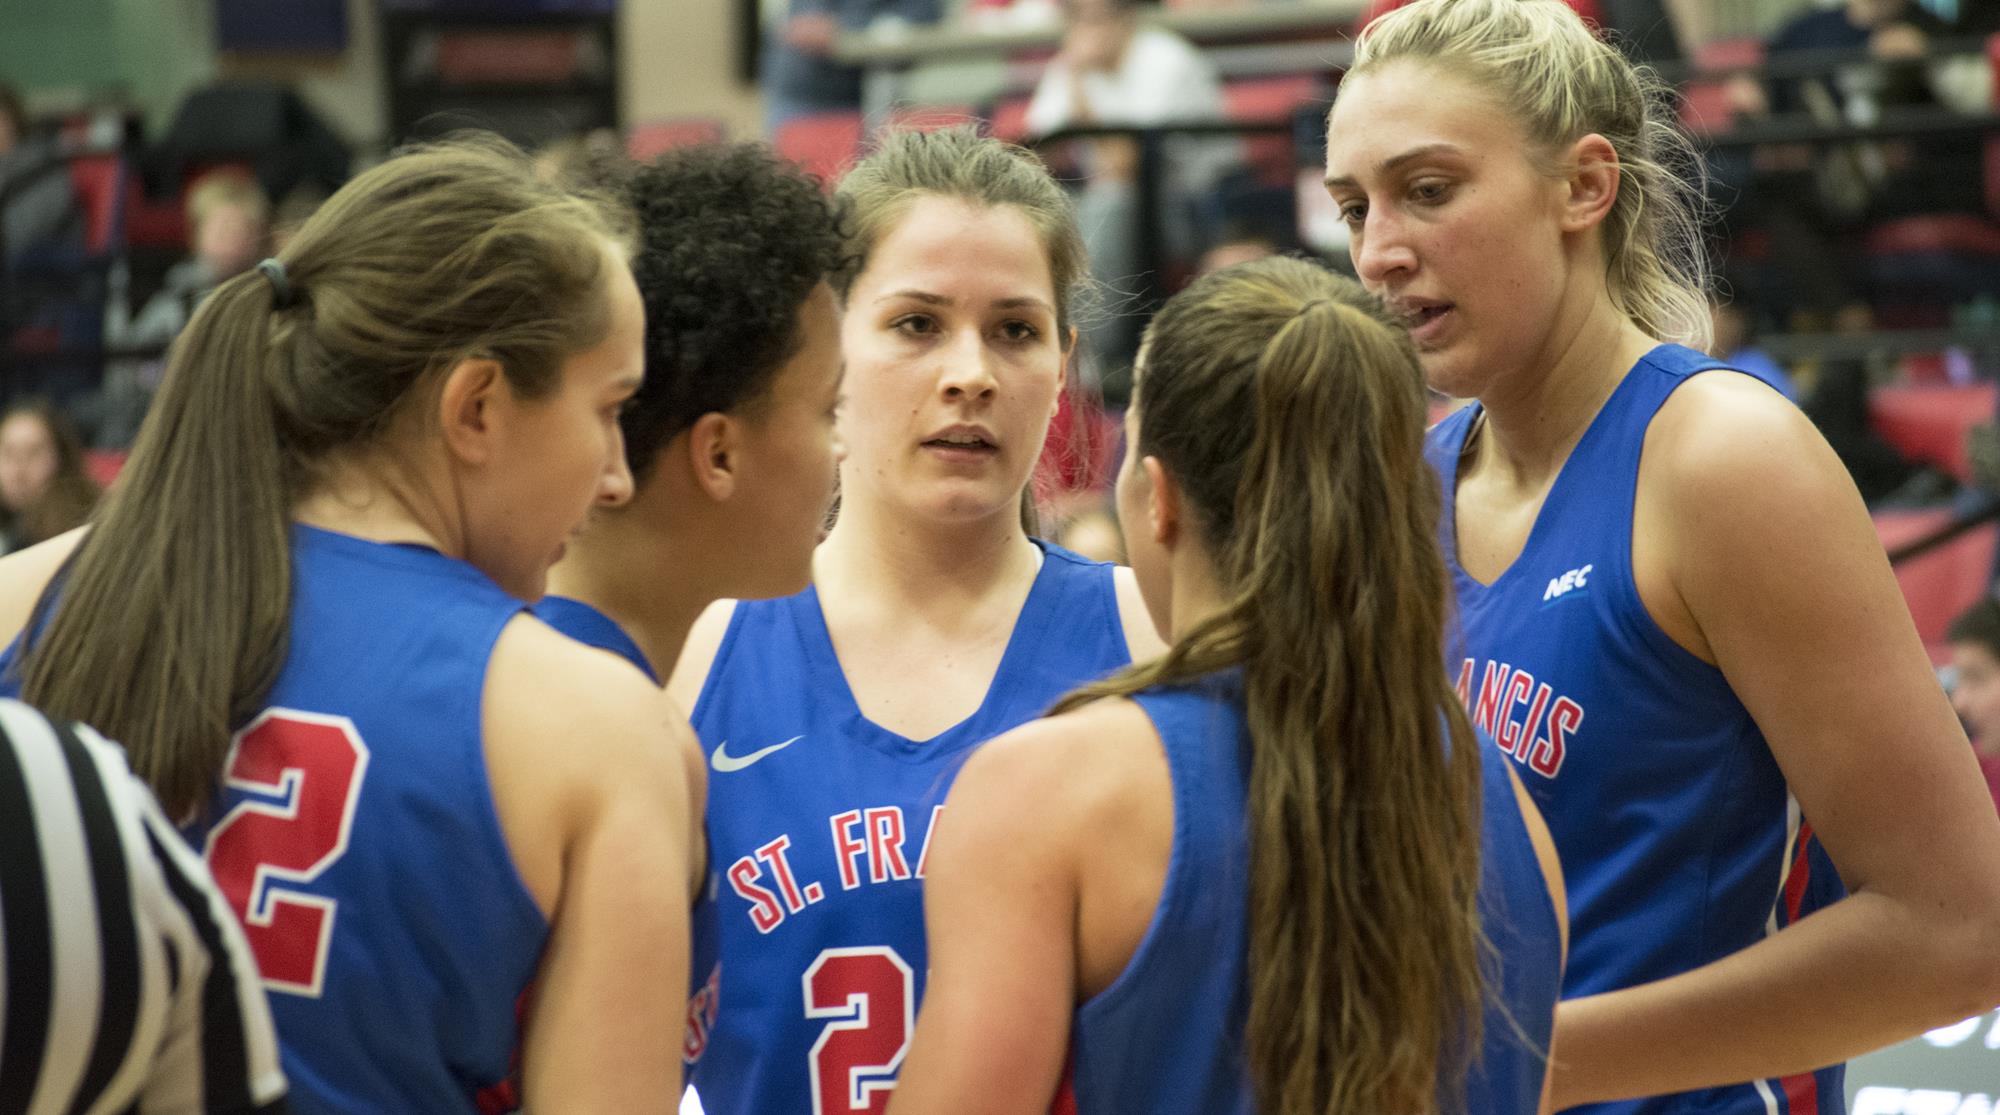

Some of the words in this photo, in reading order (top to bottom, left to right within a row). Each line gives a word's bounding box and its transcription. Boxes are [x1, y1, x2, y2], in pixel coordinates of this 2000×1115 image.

[1542, 564, 1593, 601] NEC
[201, 706, 371, 999] 2
[726, 833, 824, 935] ST.
